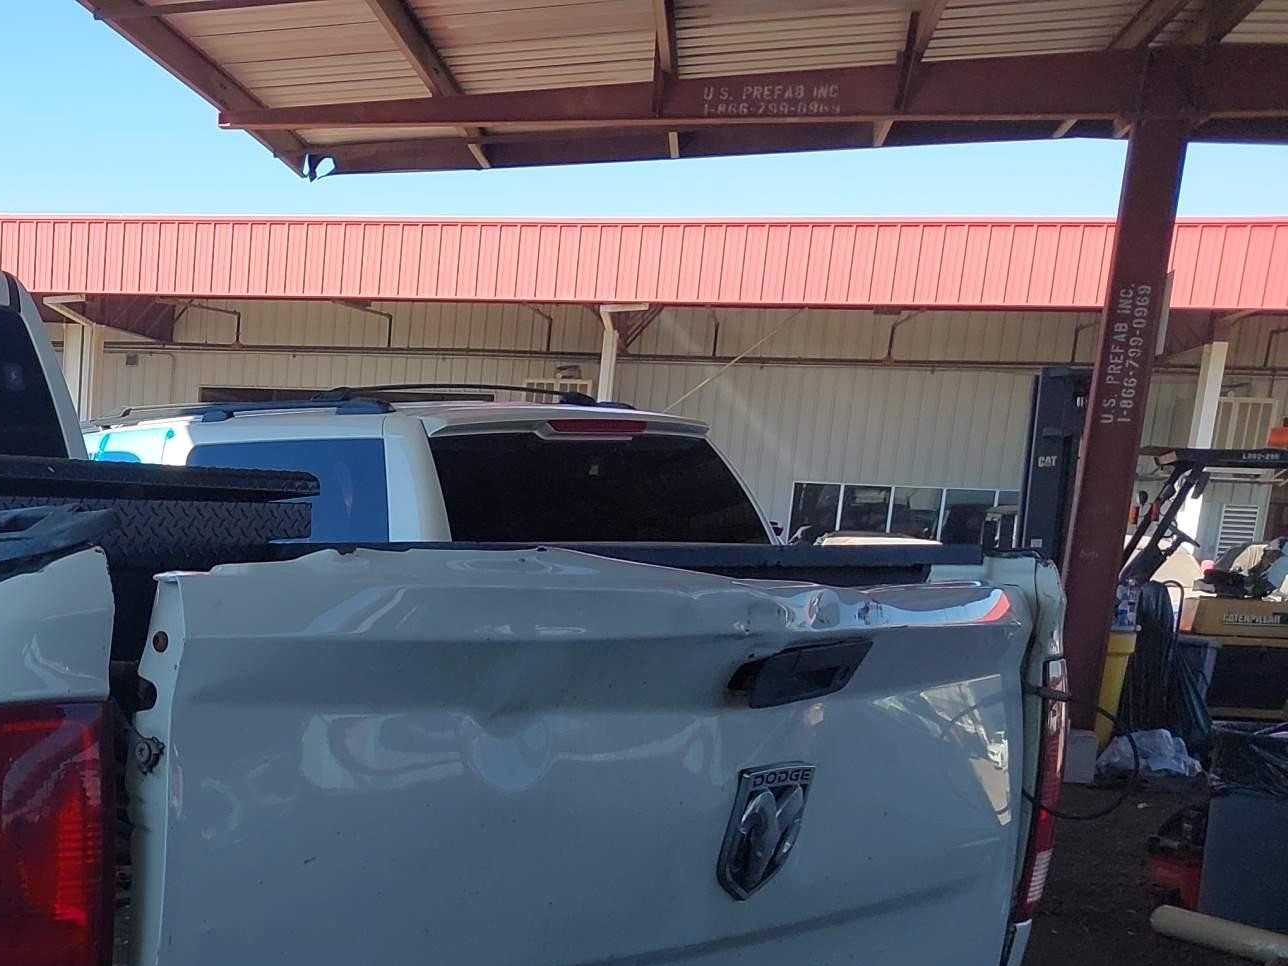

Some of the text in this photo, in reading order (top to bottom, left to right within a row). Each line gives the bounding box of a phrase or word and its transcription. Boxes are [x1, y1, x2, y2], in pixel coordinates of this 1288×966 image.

[742, 84, 805, 100] PREFAB
[1105, 322, 1129, 384] PREFAB
[1038, 456, 1058, 468] CAT
[752, 768, 812, 788] DODGE
